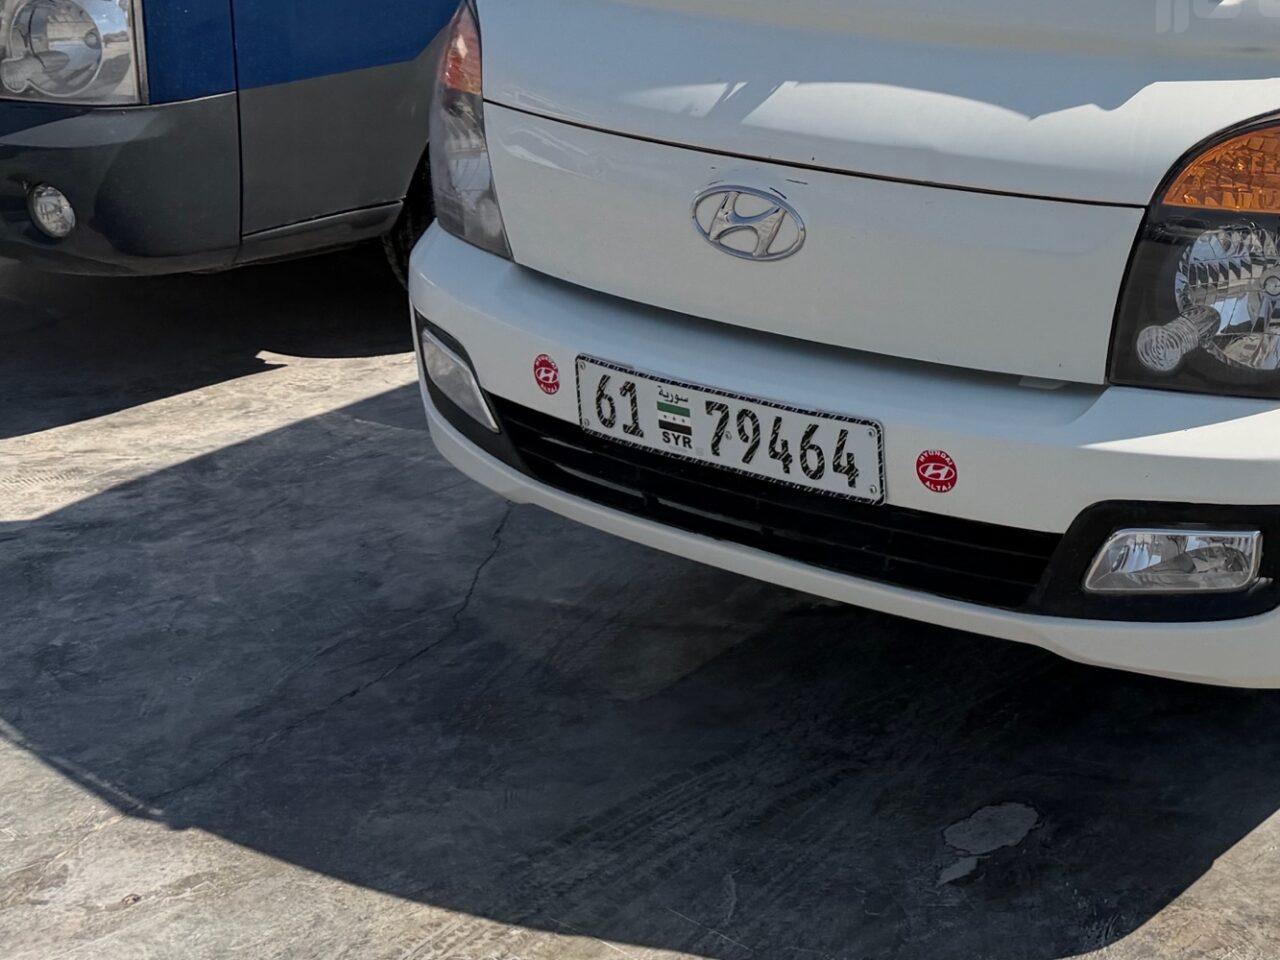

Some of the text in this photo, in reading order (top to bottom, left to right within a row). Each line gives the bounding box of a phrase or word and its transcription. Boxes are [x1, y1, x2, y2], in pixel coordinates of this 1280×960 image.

[657, 385, 689, 404] سورية
[595, 374, 859, 489] 61 79464
[662, 431, 693, 449] SYR
[919, 450, 953, 465] HYUNDAI
[925, 480, 951, 491] ALTAJ
